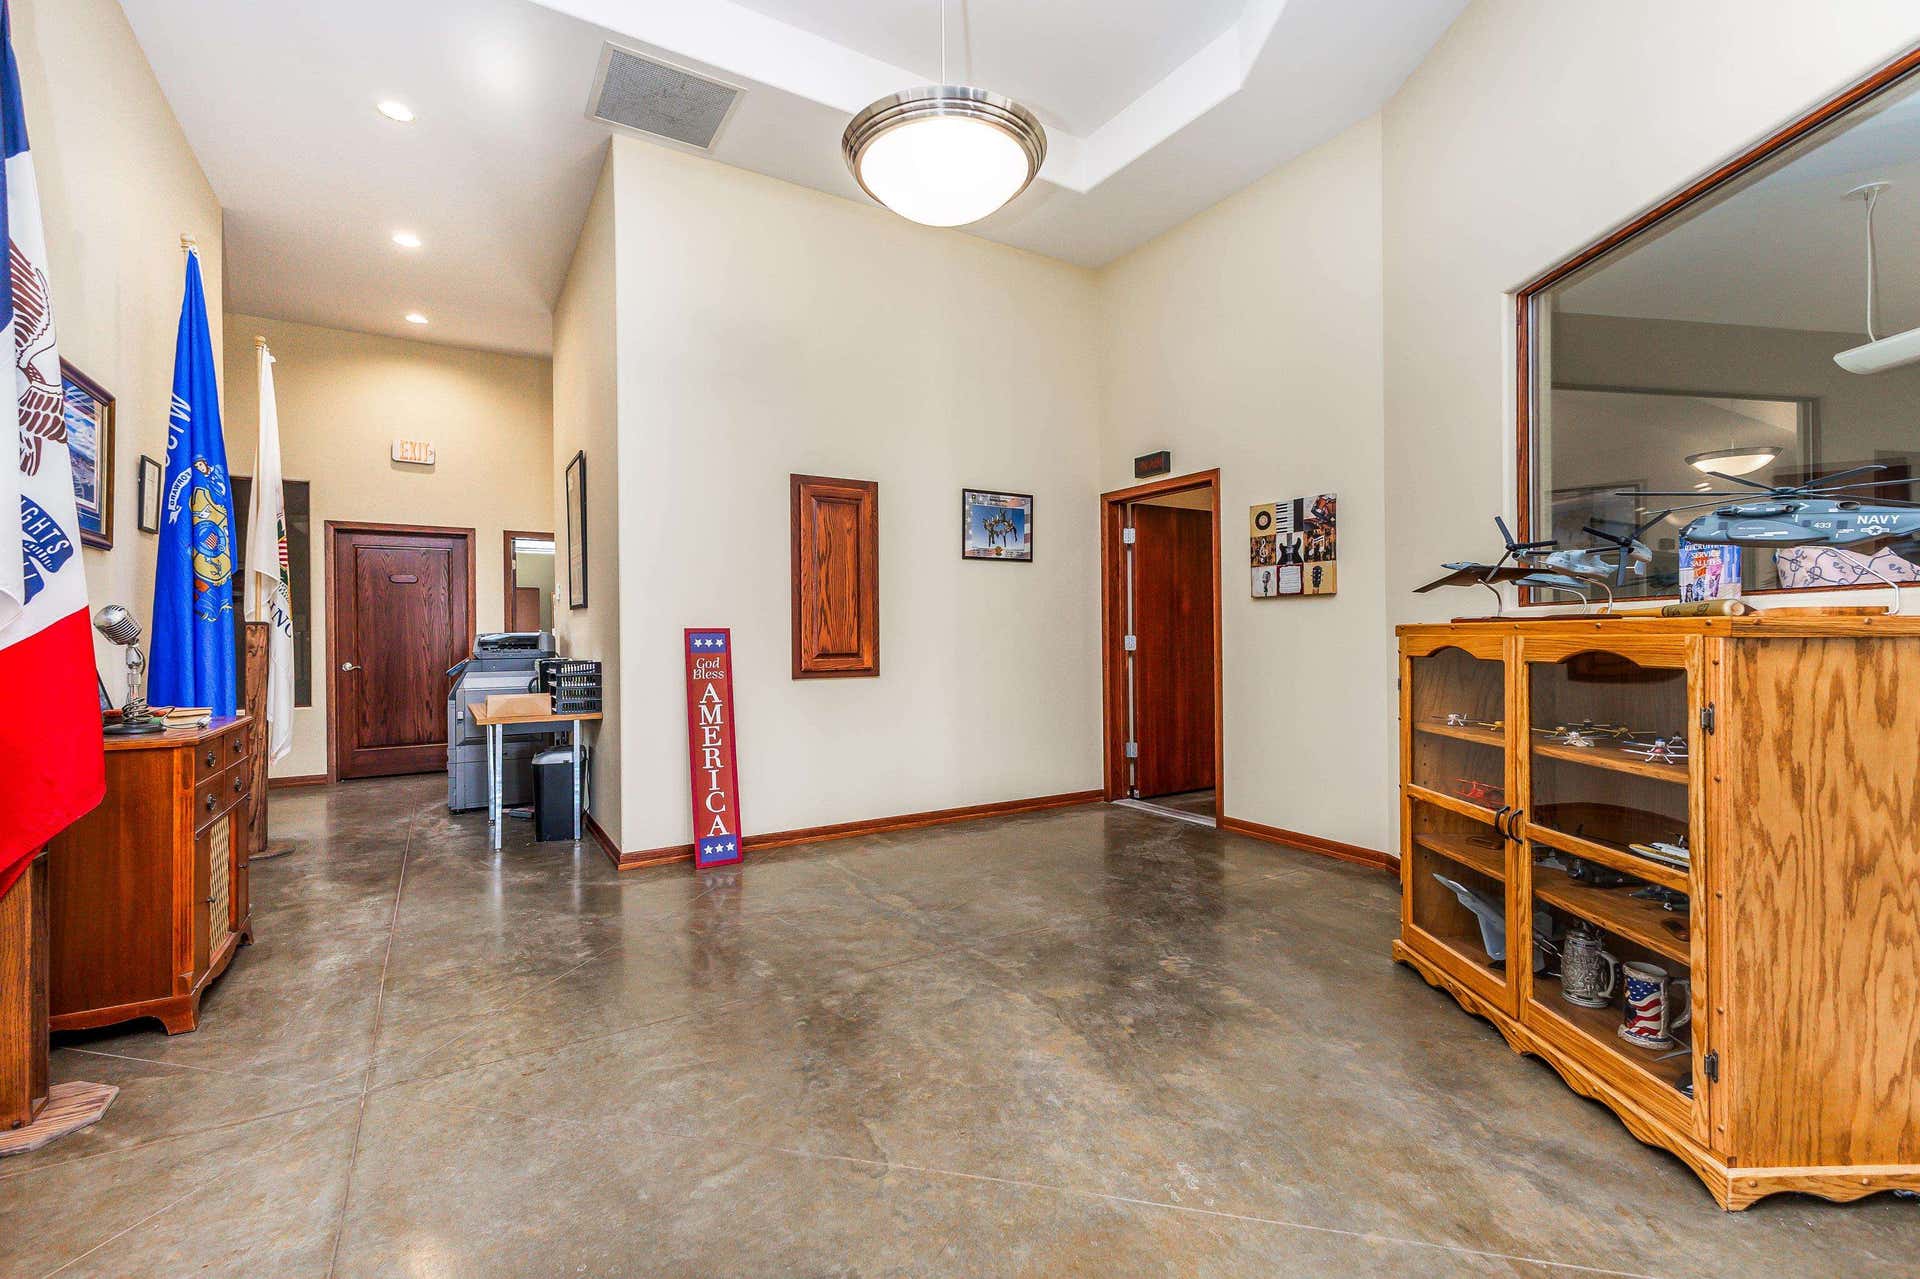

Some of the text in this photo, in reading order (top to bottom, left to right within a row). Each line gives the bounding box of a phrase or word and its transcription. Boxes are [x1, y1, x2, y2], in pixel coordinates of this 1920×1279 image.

[400, 440, 428, 462] EXIT
[1857, 514, 1900, 524] NAVY
[696, 657, 720, 669] God
[693, 668, 725, 680] Bless
[698, 682, 730, 837] AMERICA
